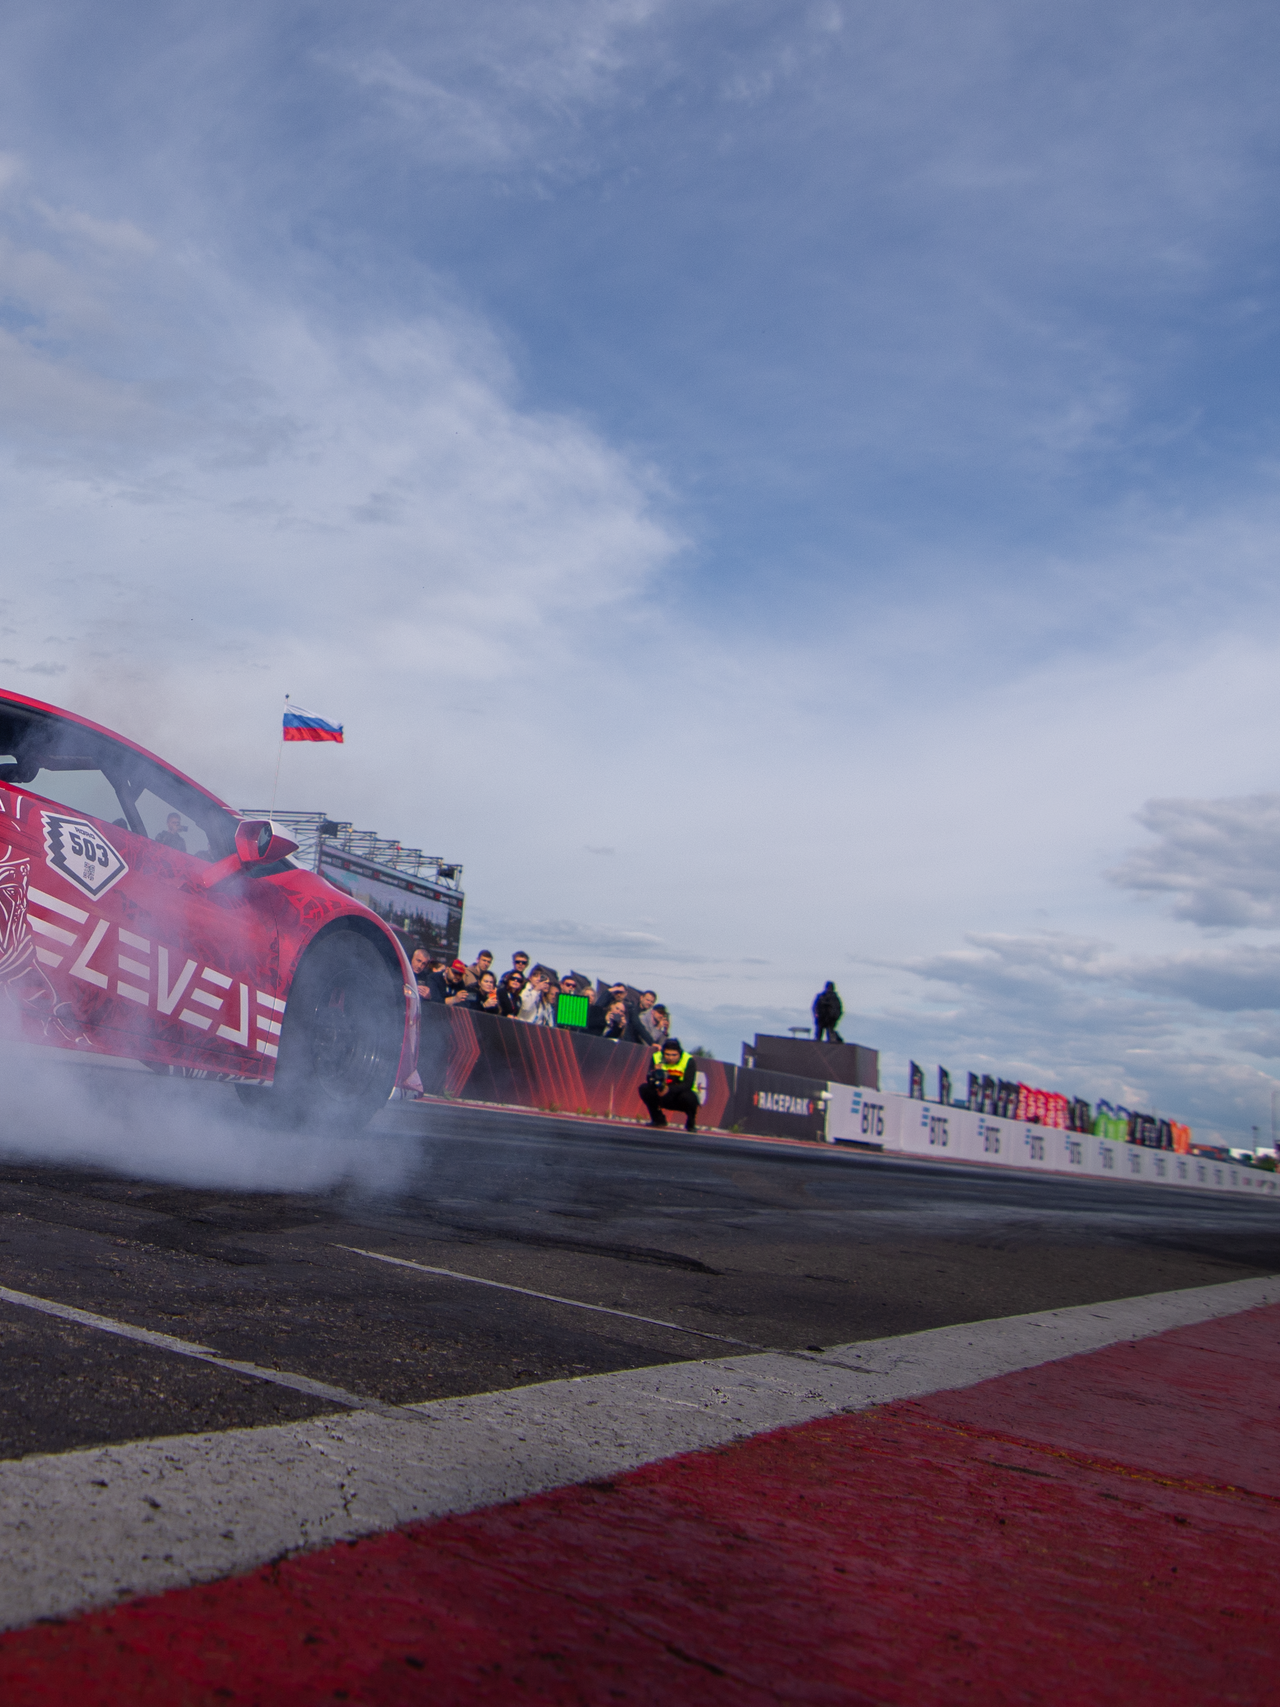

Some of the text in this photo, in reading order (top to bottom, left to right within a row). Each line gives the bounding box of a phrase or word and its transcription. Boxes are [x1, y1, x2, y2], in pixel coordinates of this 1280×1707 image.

[68, 831, 109, 868] 503
[758, 1091, 810, 1116] RACEPARK
[861, 1101, 884, 1136] ВТБ
